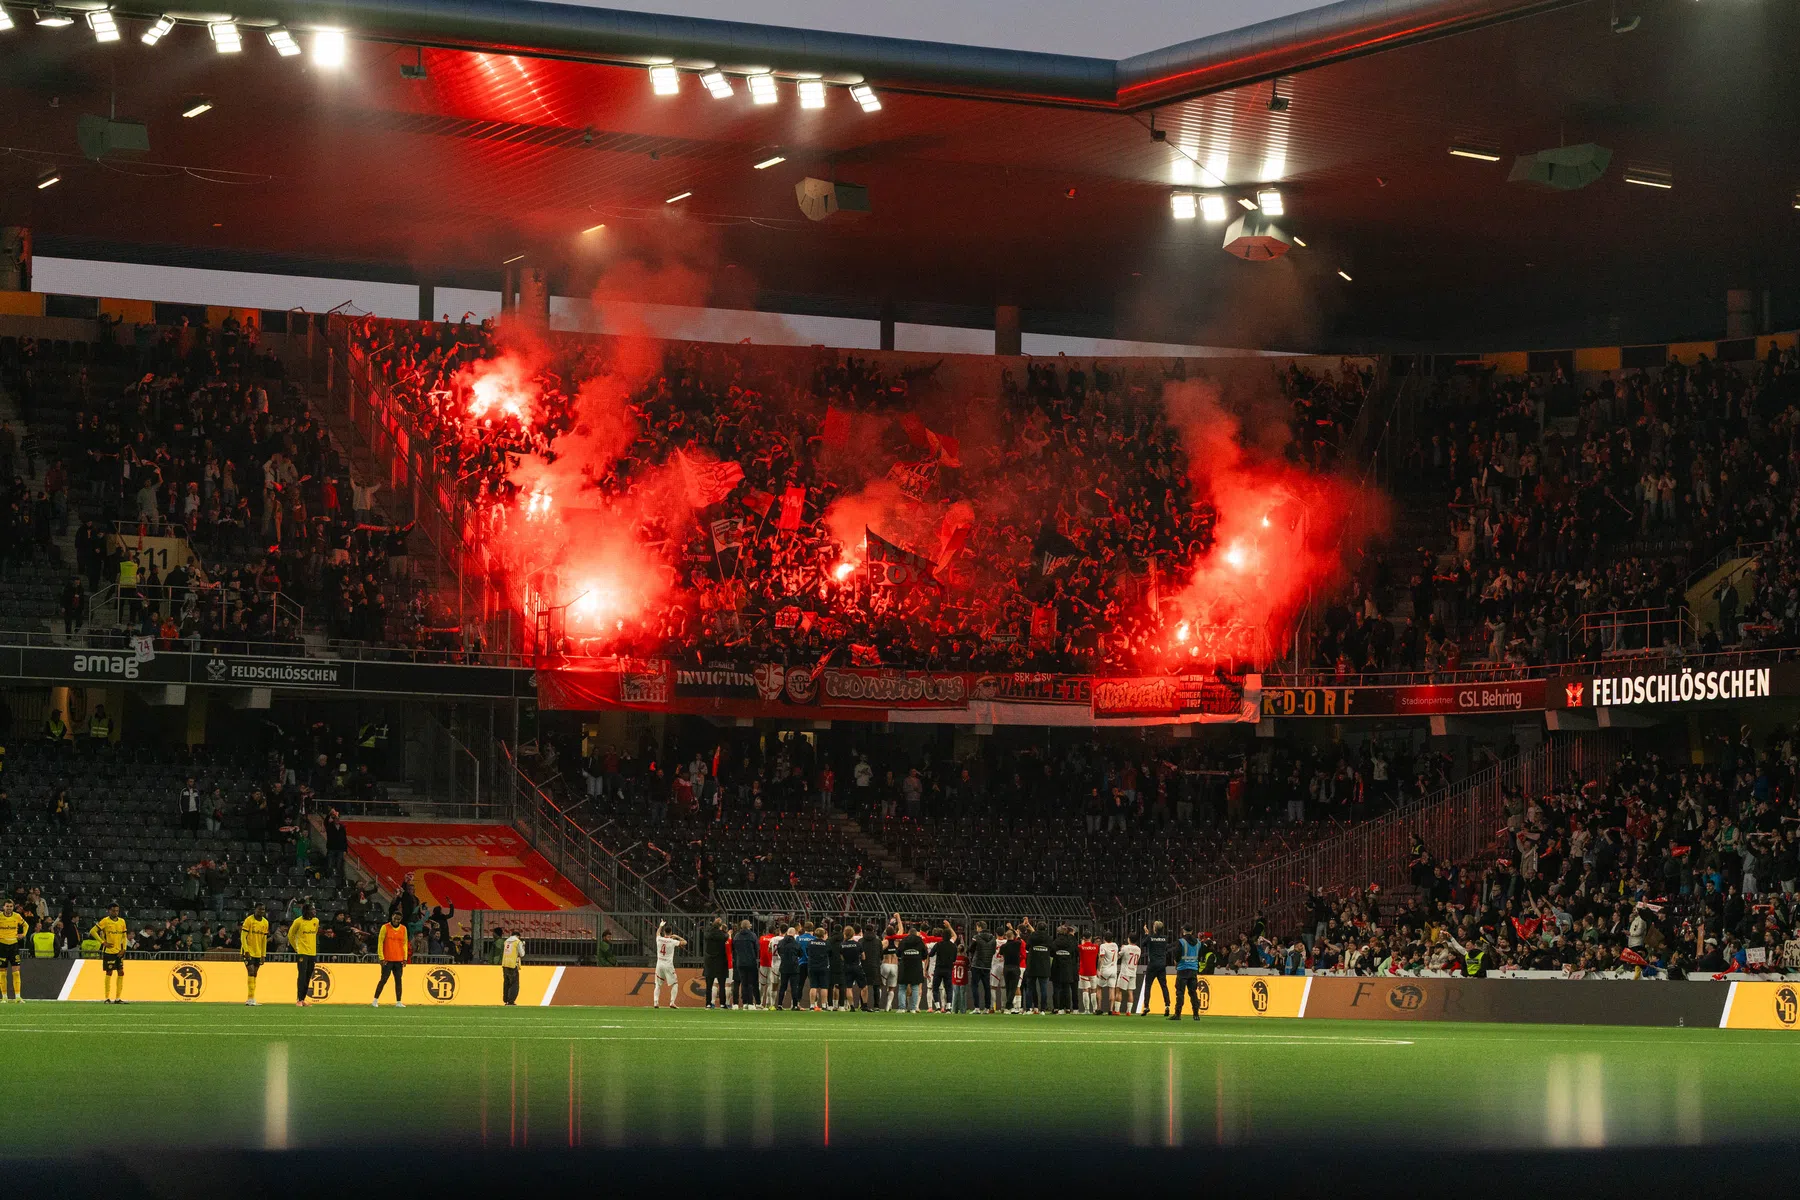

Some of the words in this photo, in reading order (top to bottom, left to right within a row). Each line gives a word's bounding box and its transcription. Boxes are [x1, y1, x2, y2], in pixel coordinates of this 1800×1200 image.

[138, 640, 150, 652] 74
[73, 655, 139, 679] amag
[231, 665, 338, 681] FELDSCHLÖSSCHEN
[676, 670, 755, 686] INVICTUS
[1592, 668, 1771, 706] FELDSCHLÖSSCHEN
[1459, 691, 1480, 707] CSL
[1482, 688, 1522, 709] Behring
[348, 834, 518, 847] McDonald's
[660, 944, 667, 957] 4
[1110, 949, 1117, 963] 7
[1129, 952, 1140, 966] 70
[953, 965, 965, 980] 10
[172, 972, 200, 996] YB
[426, 975, 453, 1000] YB
[1250, 985, 1268, 1012] YB
[1775, 995, 1797, 1023] YB
